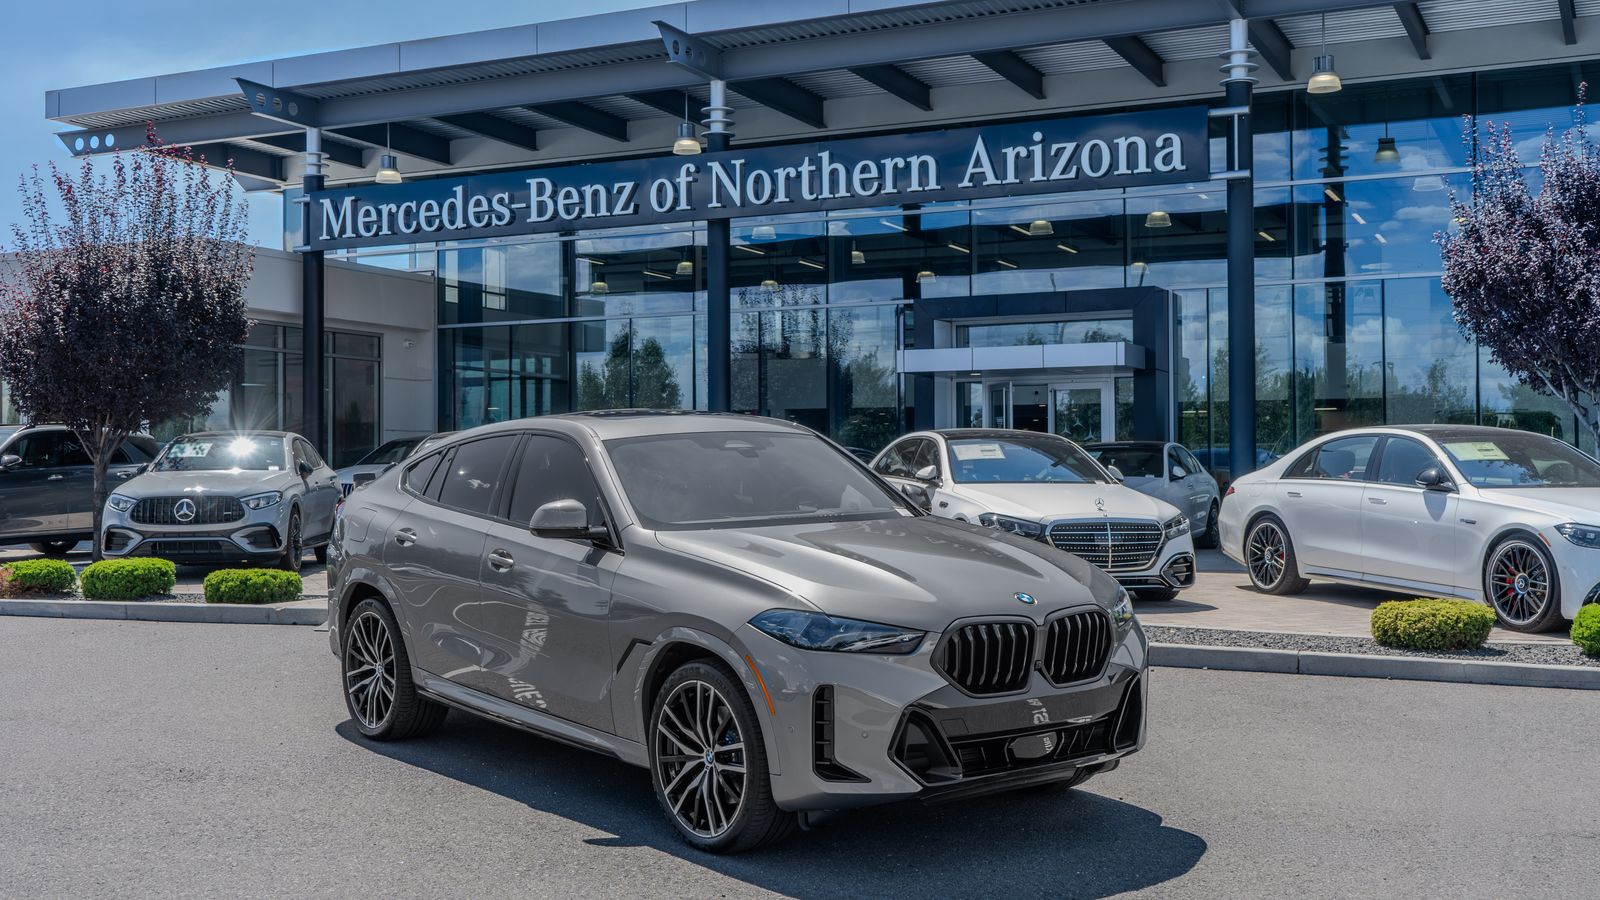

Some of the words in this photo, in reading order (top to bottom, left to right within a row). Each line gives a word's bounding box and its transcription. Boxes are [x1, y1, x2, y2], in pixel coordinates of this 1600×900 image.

[319, 177, 636, 241] Mercedes-Benz
[650, 163, 698, 213] of
[707, 154, 940, 211] Northern
[958, 130, 1186, 188] Arizona
